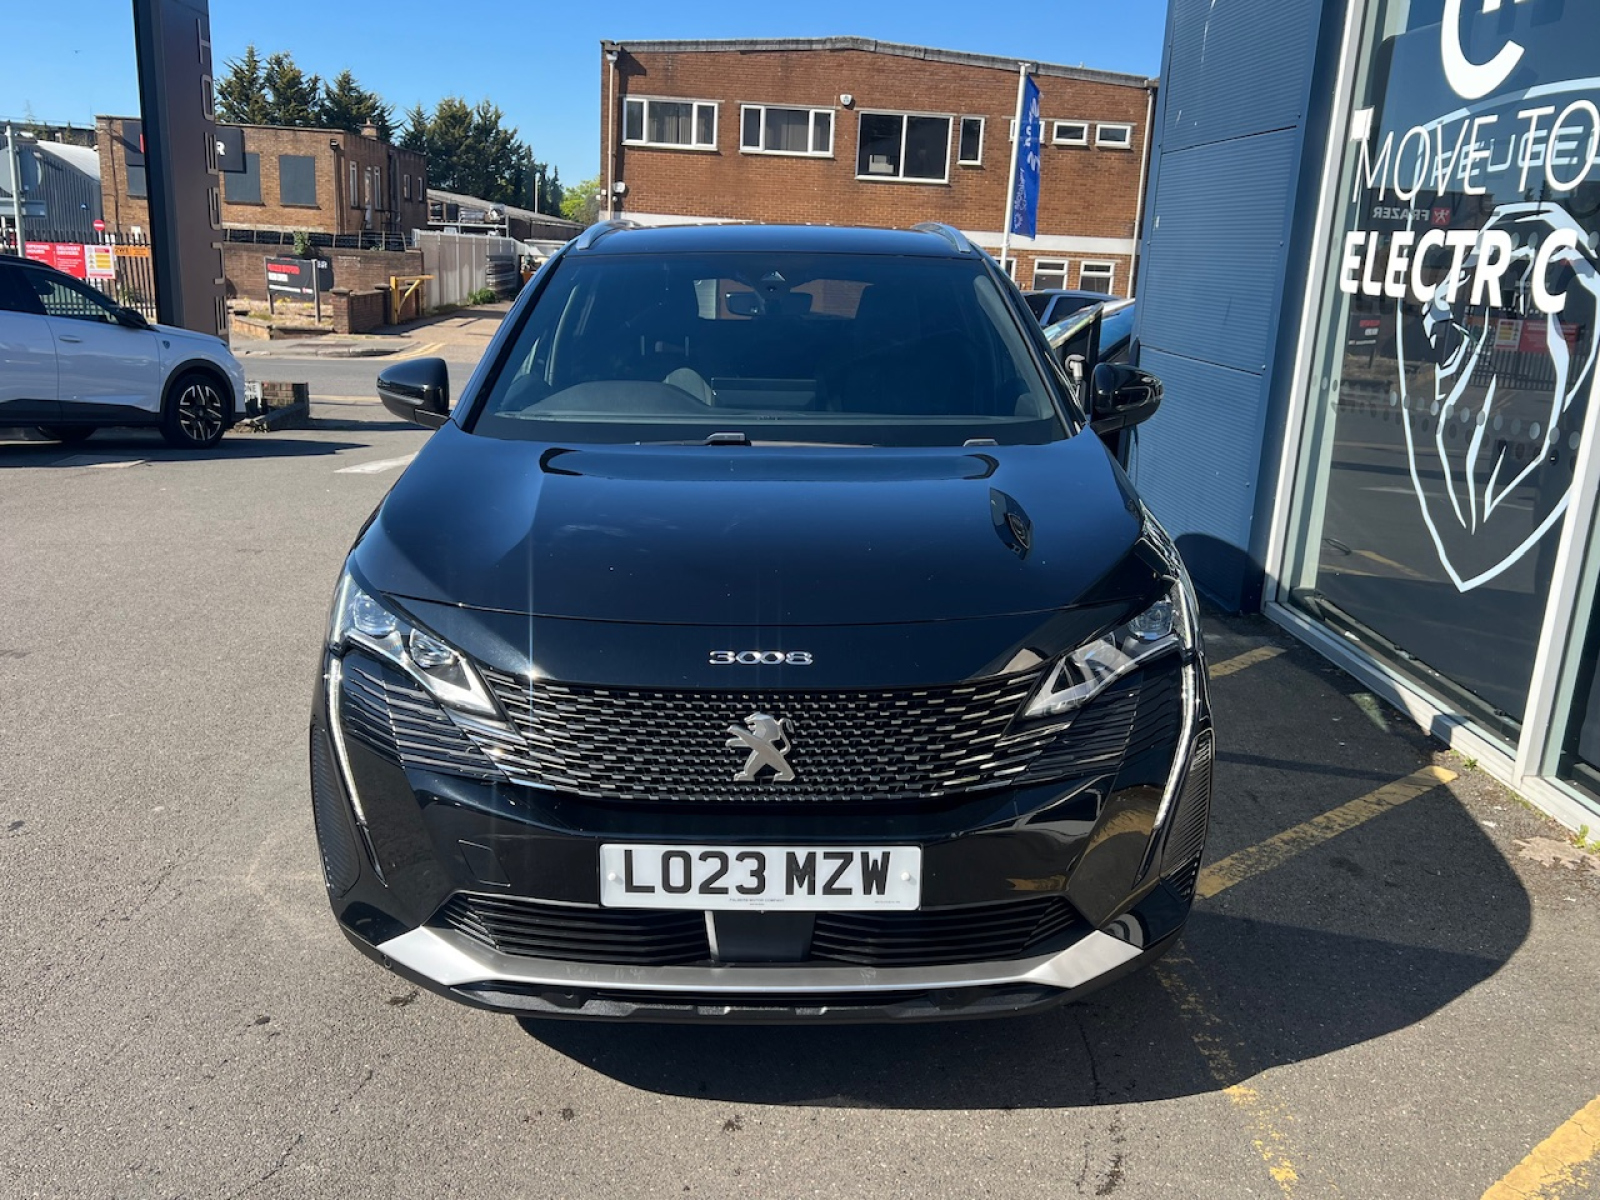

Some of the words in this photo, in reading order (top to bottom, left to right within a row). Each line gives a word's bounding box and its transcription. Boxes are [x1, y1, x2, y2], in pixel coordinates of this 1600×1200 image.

[1352, 114, 1499, 203] MOVE
[1517, 99, 1600, 193] TO
[1339, 228, 1578, 314] ELECTRC
[709, 650, 814, 665] 3008
[624, 849, 766, 895] LO23
[785, 851, 891, 896] MZW
